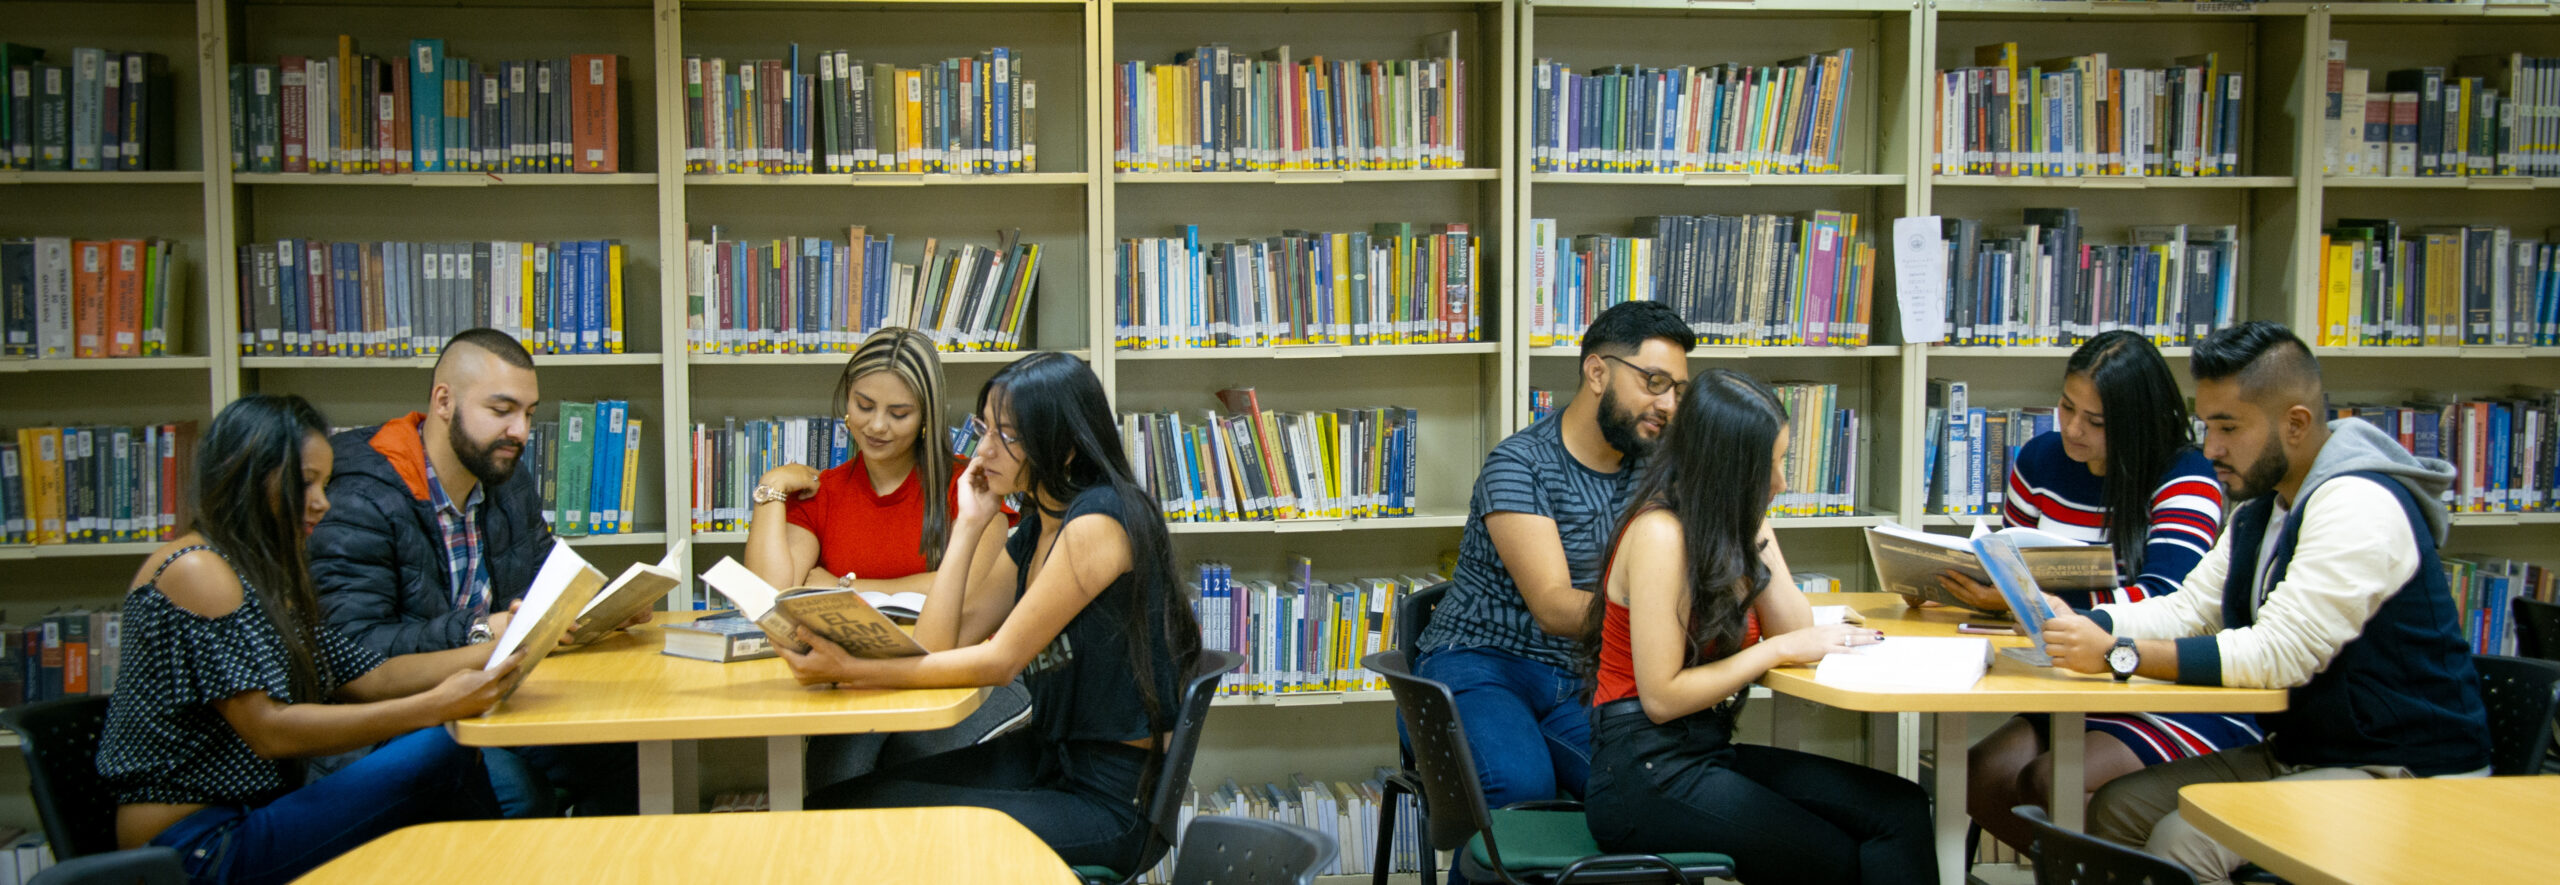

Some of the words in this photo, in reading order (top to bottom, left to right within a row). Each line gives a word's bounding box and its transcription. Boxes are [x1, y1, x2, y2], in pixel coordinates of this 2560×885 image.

[2196, 3, 2252, 12] REFERENCIA
[1012, 77, 1020, 112] ENTERPRISE
[55, 98, 66, 144] LABORAL
[982, 104, 992, 144] Psychology
[1458, 237, 1467, 279] Maestro
[1535, 250, 1545, 278] DOCENTE
[60, 268, 68, 293] PENAL
[96, 265, 105, 294] PENAL
[43, 274, 51, 323] PORTAFOLIO
[60, 293, 69, 330] DERECHO
[1991, 424, 2003, 460] AIRPORT
[2415, 431, 2437, 441] DIOS
[1973, 454, 1982, 496] ENGINEERIN
[1991, 462, 2003, 492] SYSTE
[1203, 578, 1209, 591] 1
[1214, 578, 1223, 592] 2
[1224, 578, 1231, 592] 3
[820, 611, 861, 627] EL
